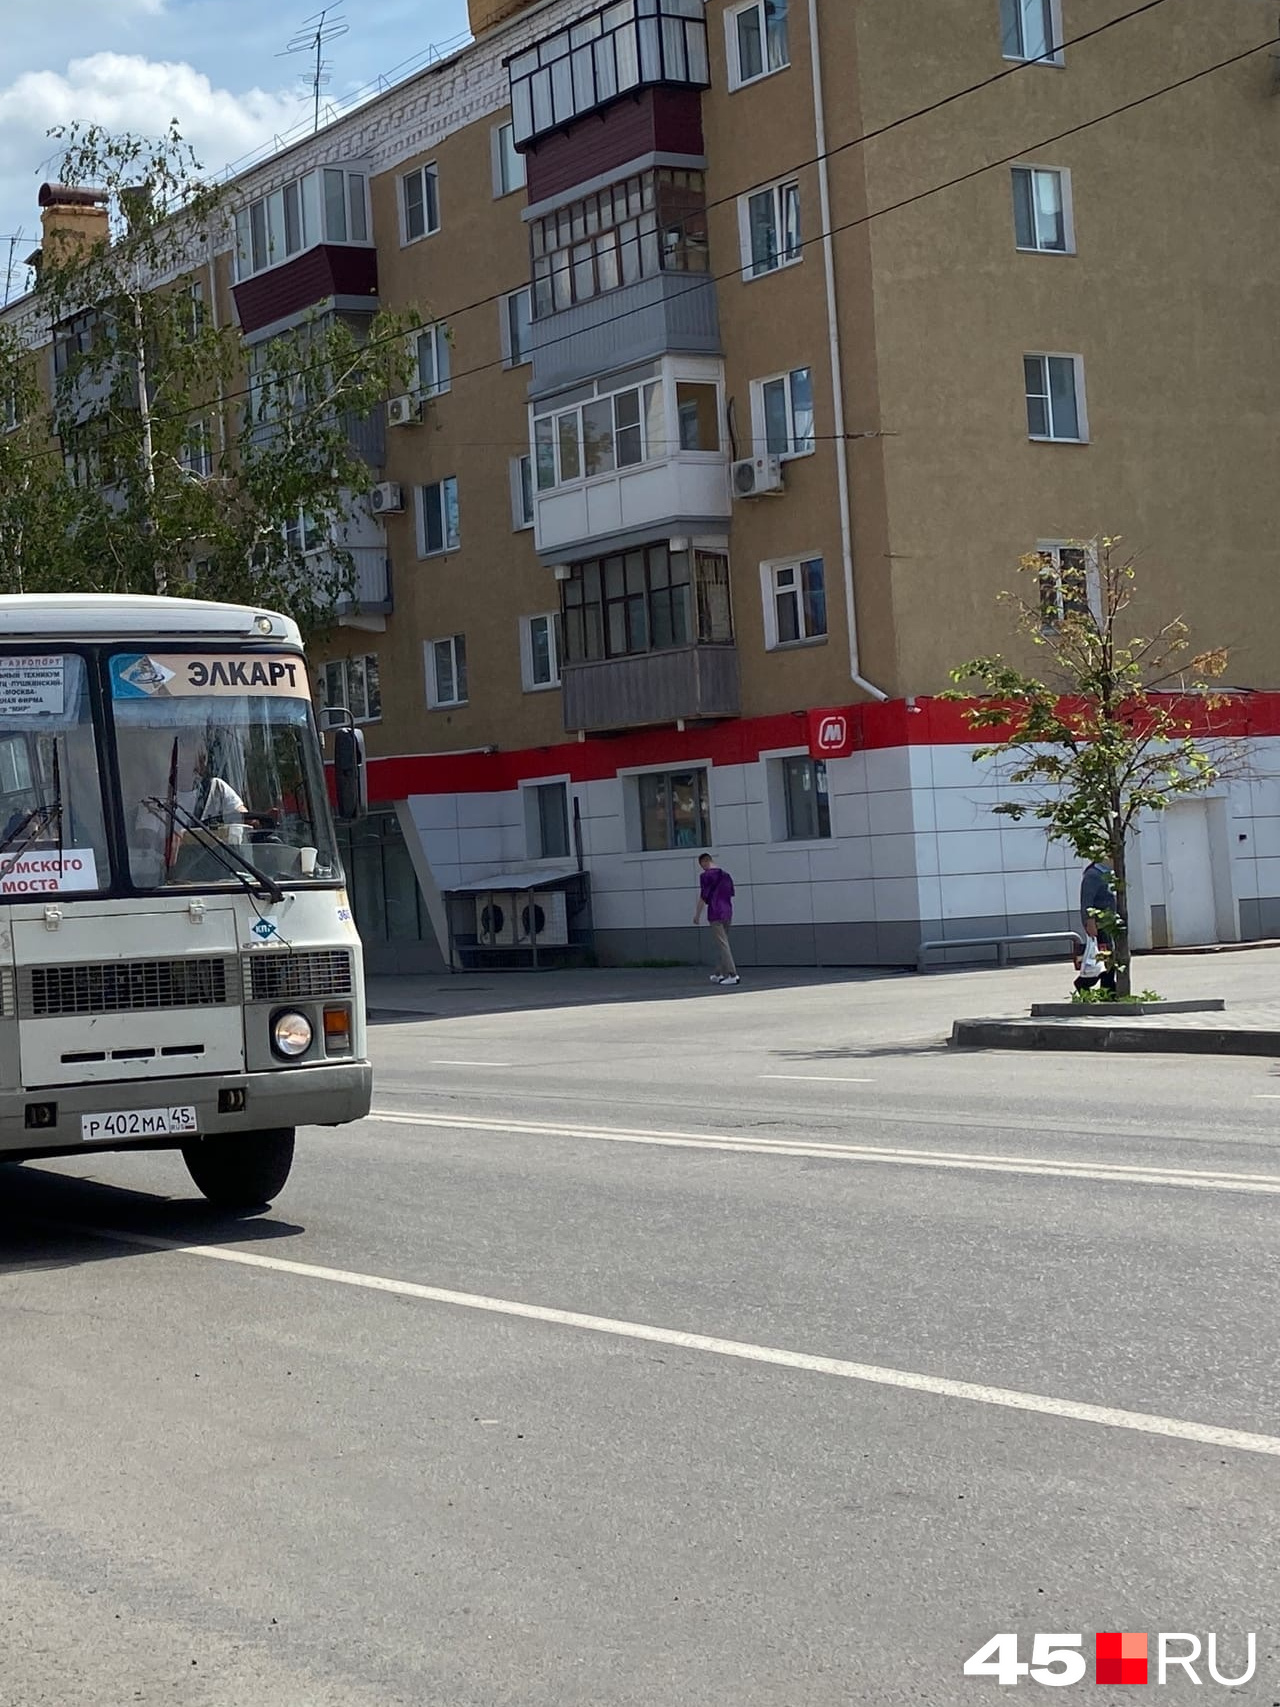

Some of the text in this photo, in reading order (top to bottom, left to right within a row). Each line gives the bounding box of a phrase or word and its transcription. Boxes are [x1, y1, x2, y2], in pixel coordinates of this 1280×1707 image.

[8, 658, 60, 667] АЭРОПОРТ
[187, 661, 297, 687] ЭЛКАРТ
[0, 858, 83, 875] Омского
[2, 878, 59, 893] моста
[90, 1108, 190, 1137] Р402МА 45
